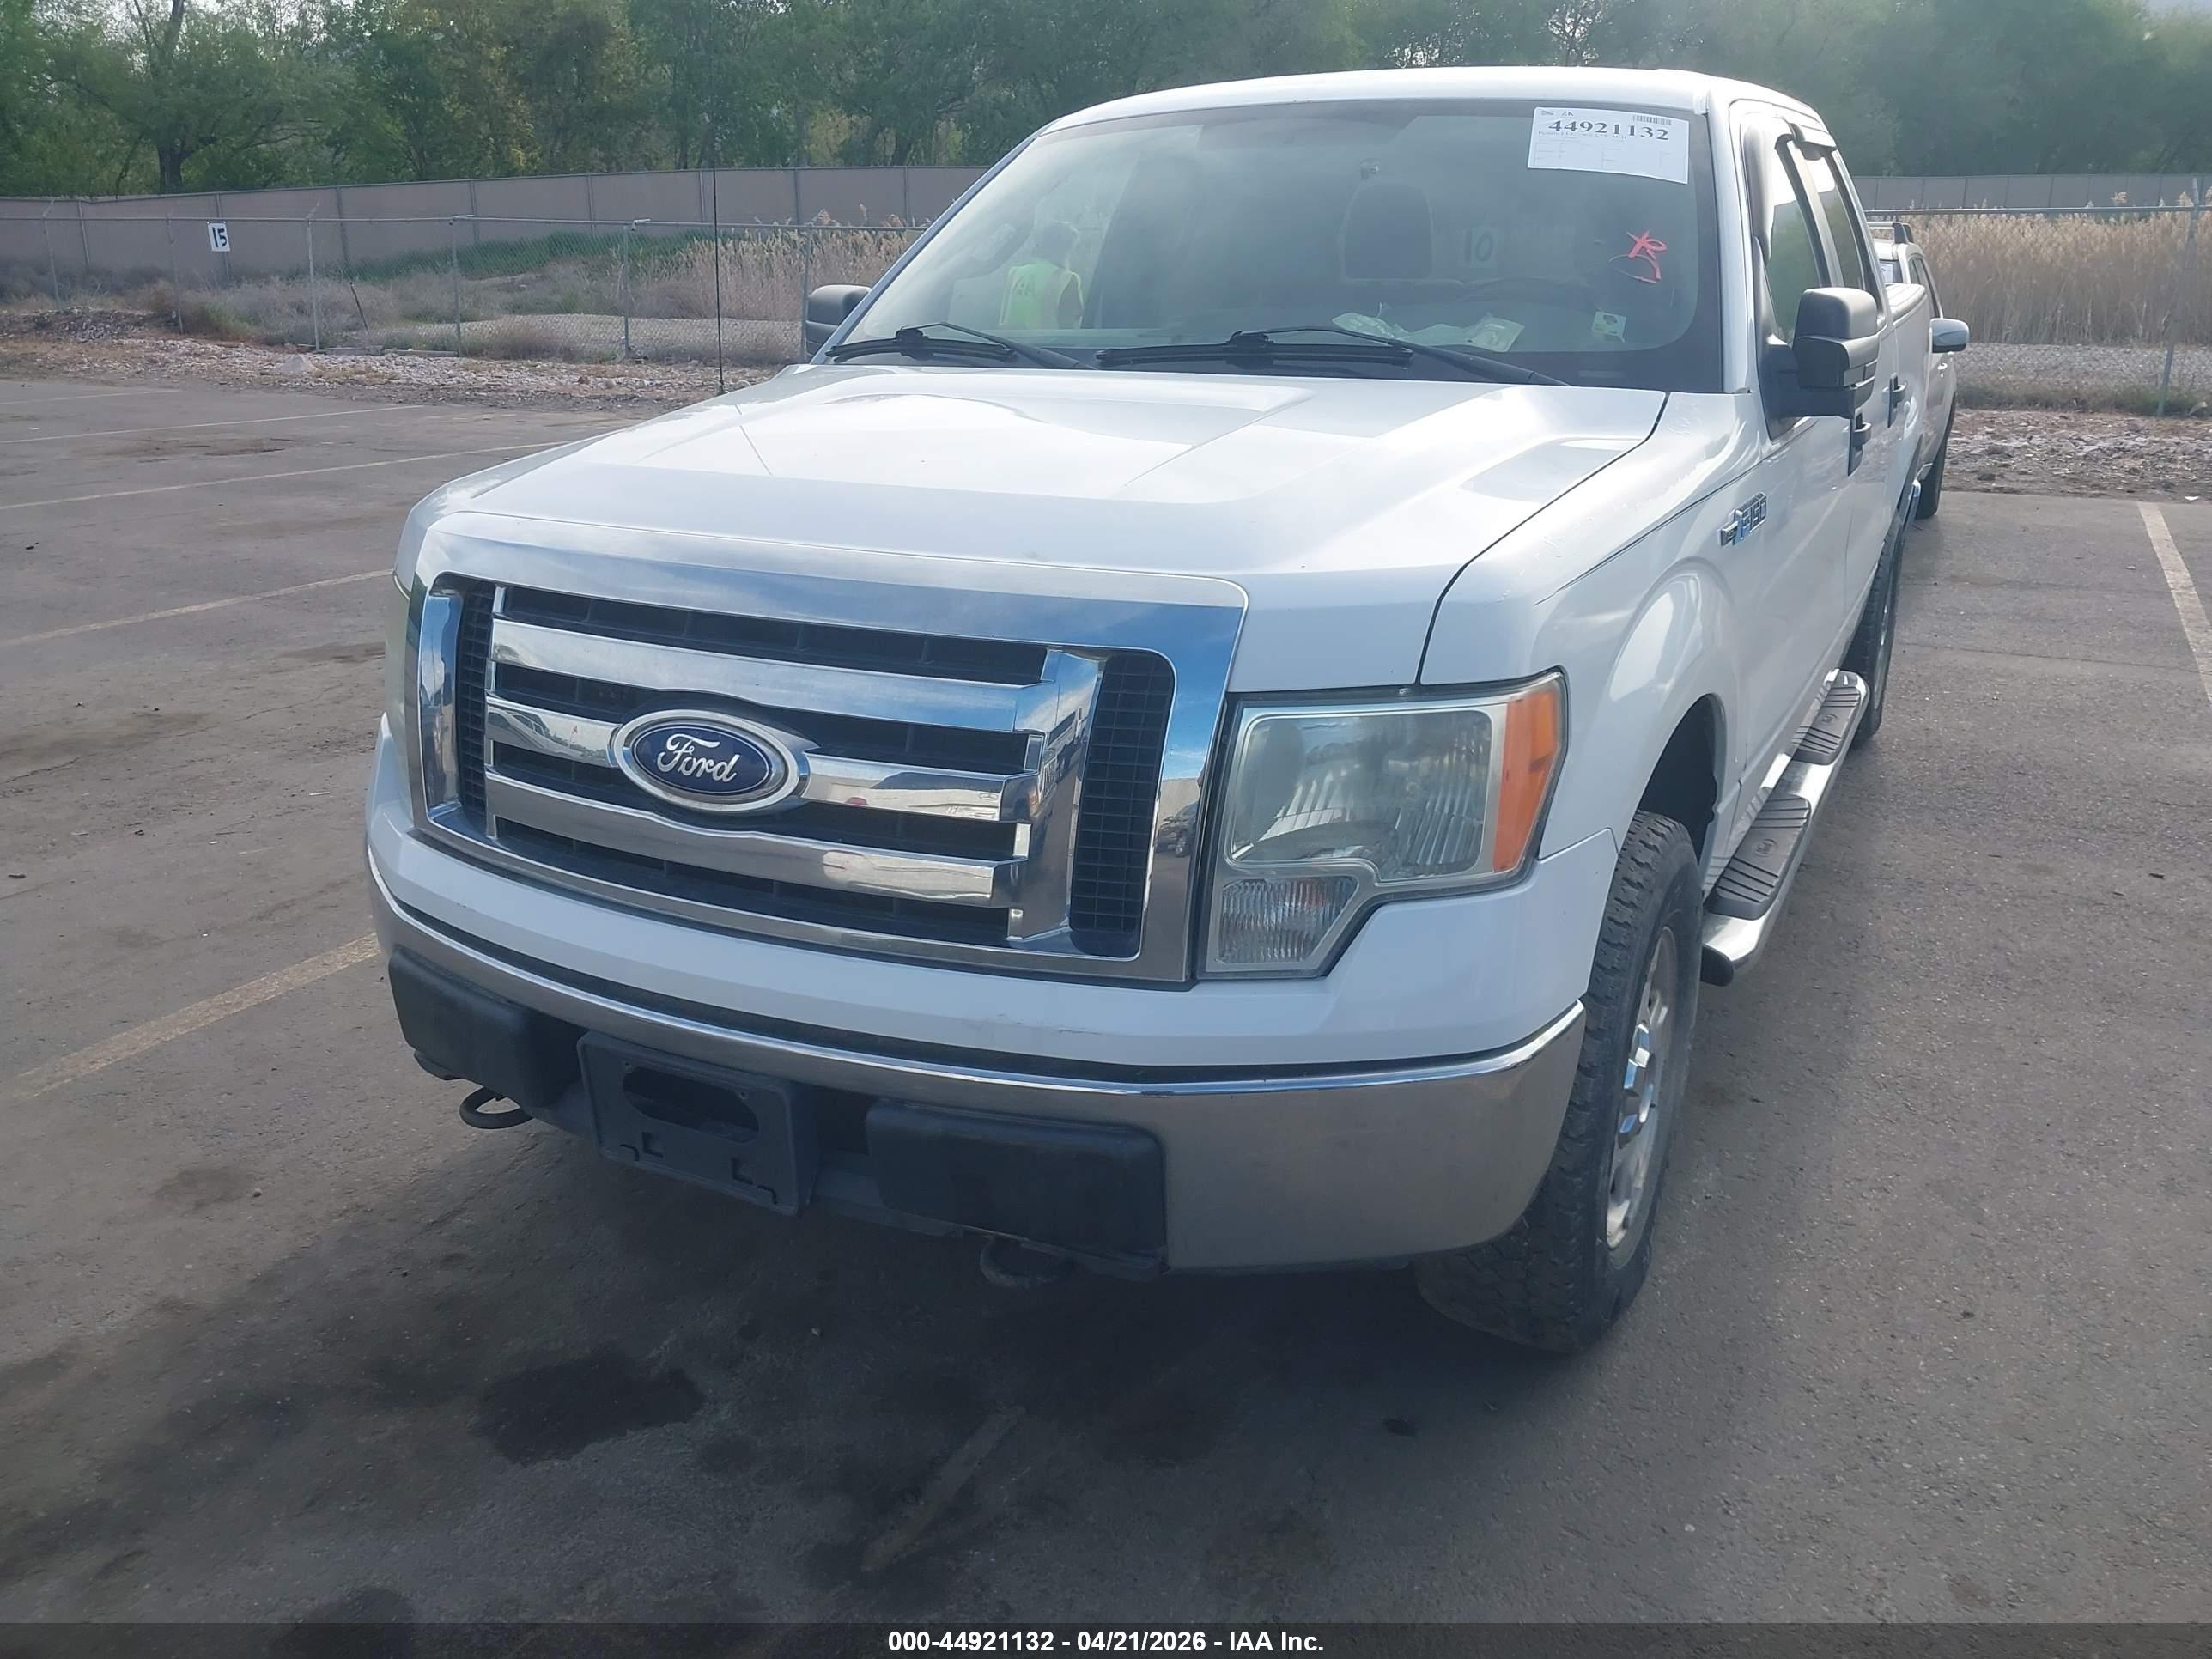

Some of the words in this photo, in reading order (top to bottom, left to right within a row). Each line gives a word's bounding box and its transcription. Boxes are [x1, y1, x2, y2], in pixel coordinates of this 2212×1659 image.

[1547, 119, 1669, 141] 44921132
[211, 226, 228, 248] 15
[657, 732, 741, 782] Ford
